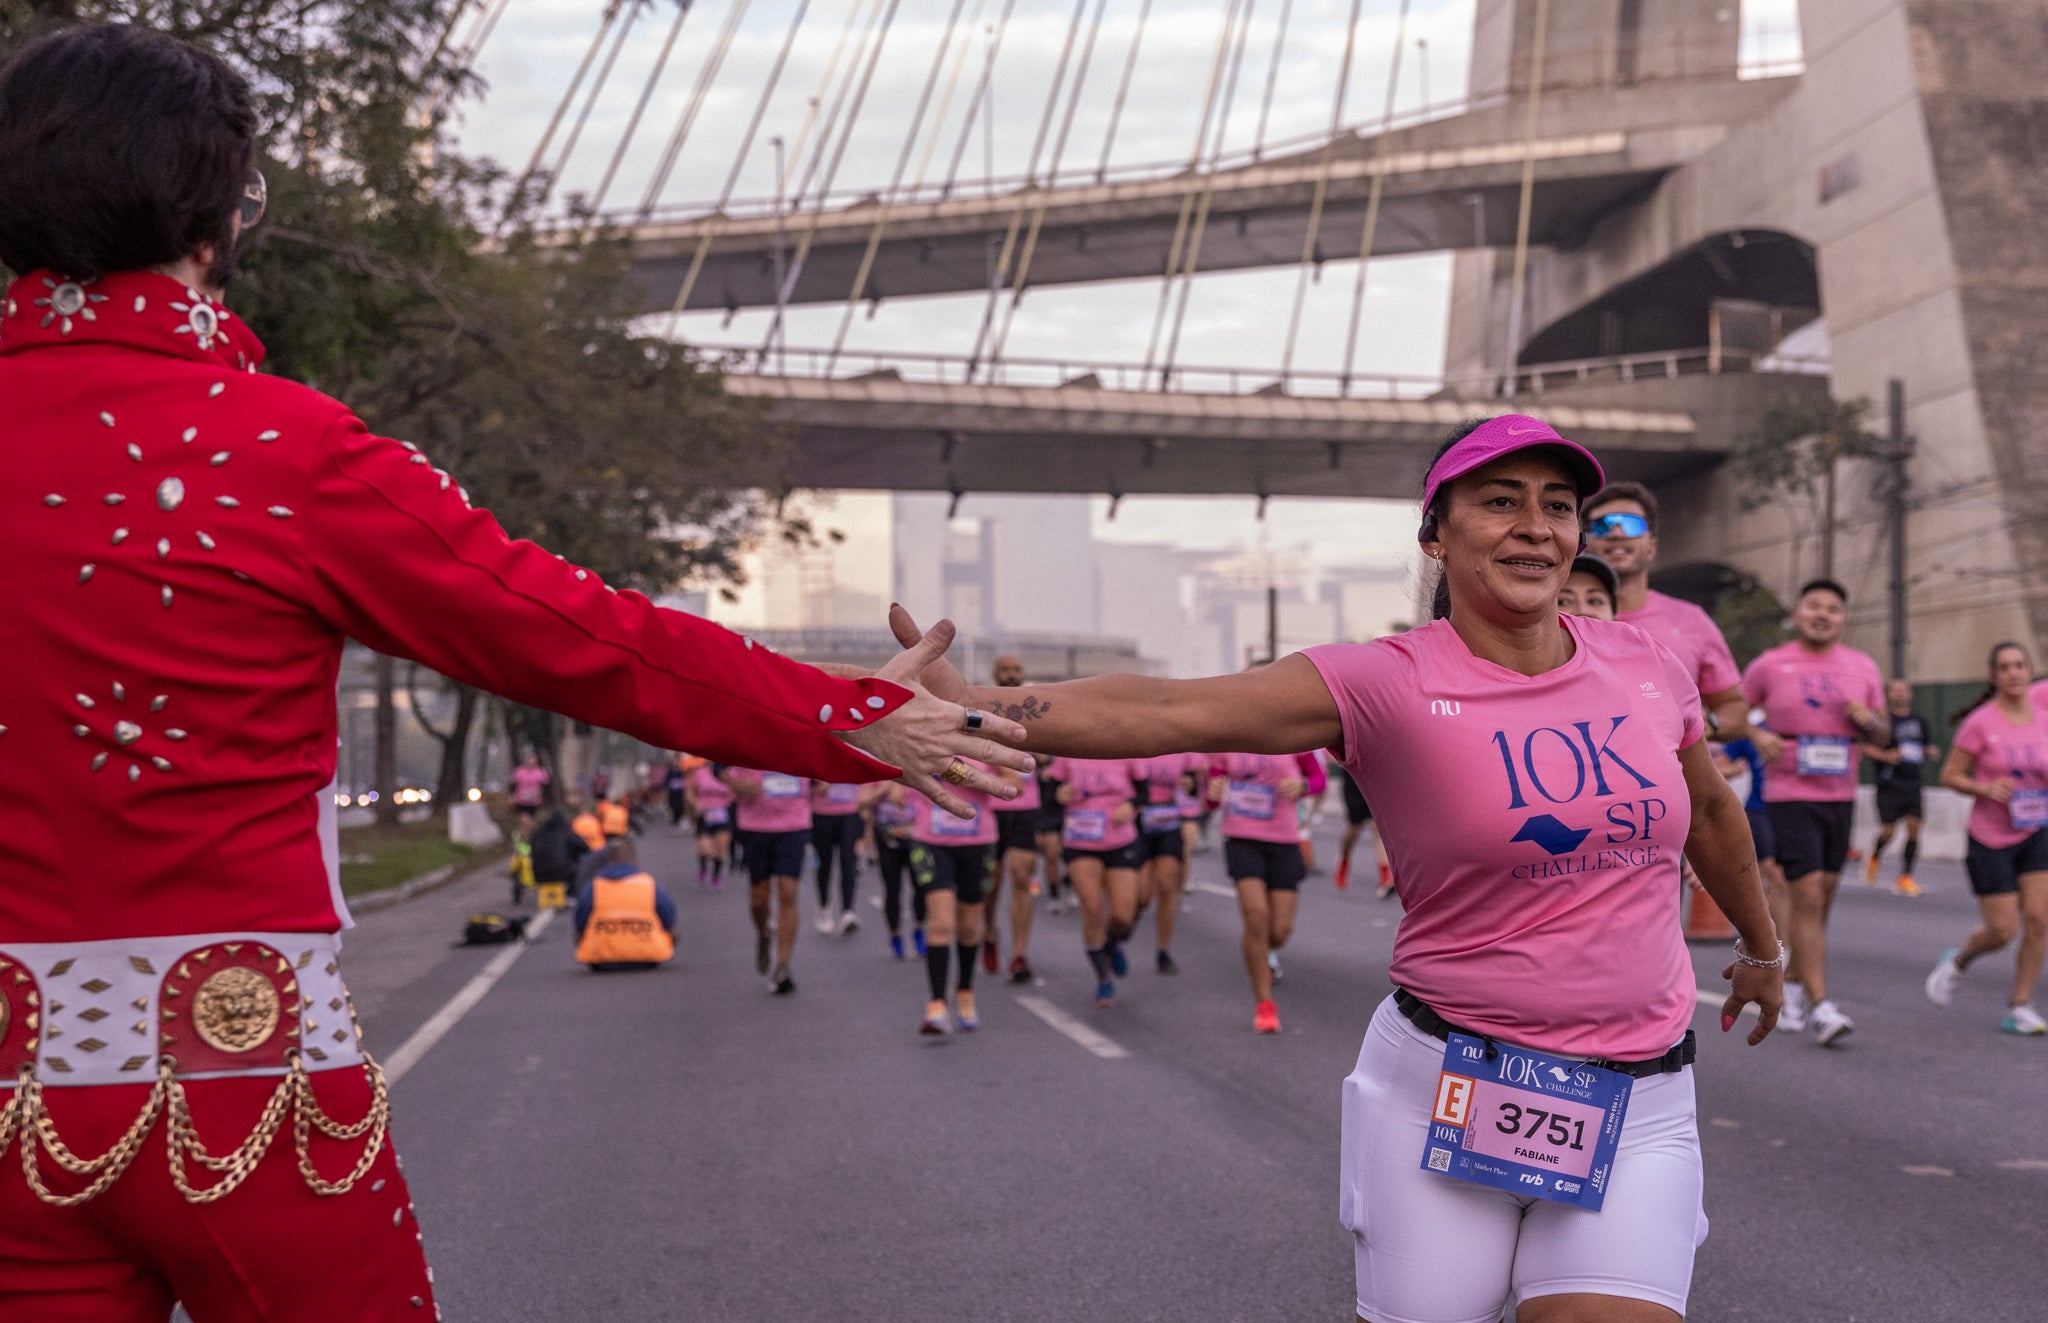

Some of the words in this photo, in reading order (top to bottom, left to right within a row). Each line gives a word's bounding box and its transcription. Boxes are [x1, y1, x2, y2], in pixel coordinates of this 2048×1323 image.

[1431, 699, 1460, 716] nu
[1491, 714, 1658, 810] 10K
[1606, 798, 1667, 844] SP
[1511, 845, 1660, 880] CHALLENGE
[1462, 1045, 1483, 1060] nu
[1498, 1053, 1546, 1089] 10K
[1574, 1071, 1596, 1089] SP
[1443, 1081, 1465, 1119] E
[1546, 1082, 1593, 1099] CHALLENGE
[1434, 1125, 1460, 1143] 10K
[1495, 1103, 1585, 1151] 3751
[1514, 1147, 1560, 1164] FABIANE
[1591, 1168, 1602, 1187] 3751
